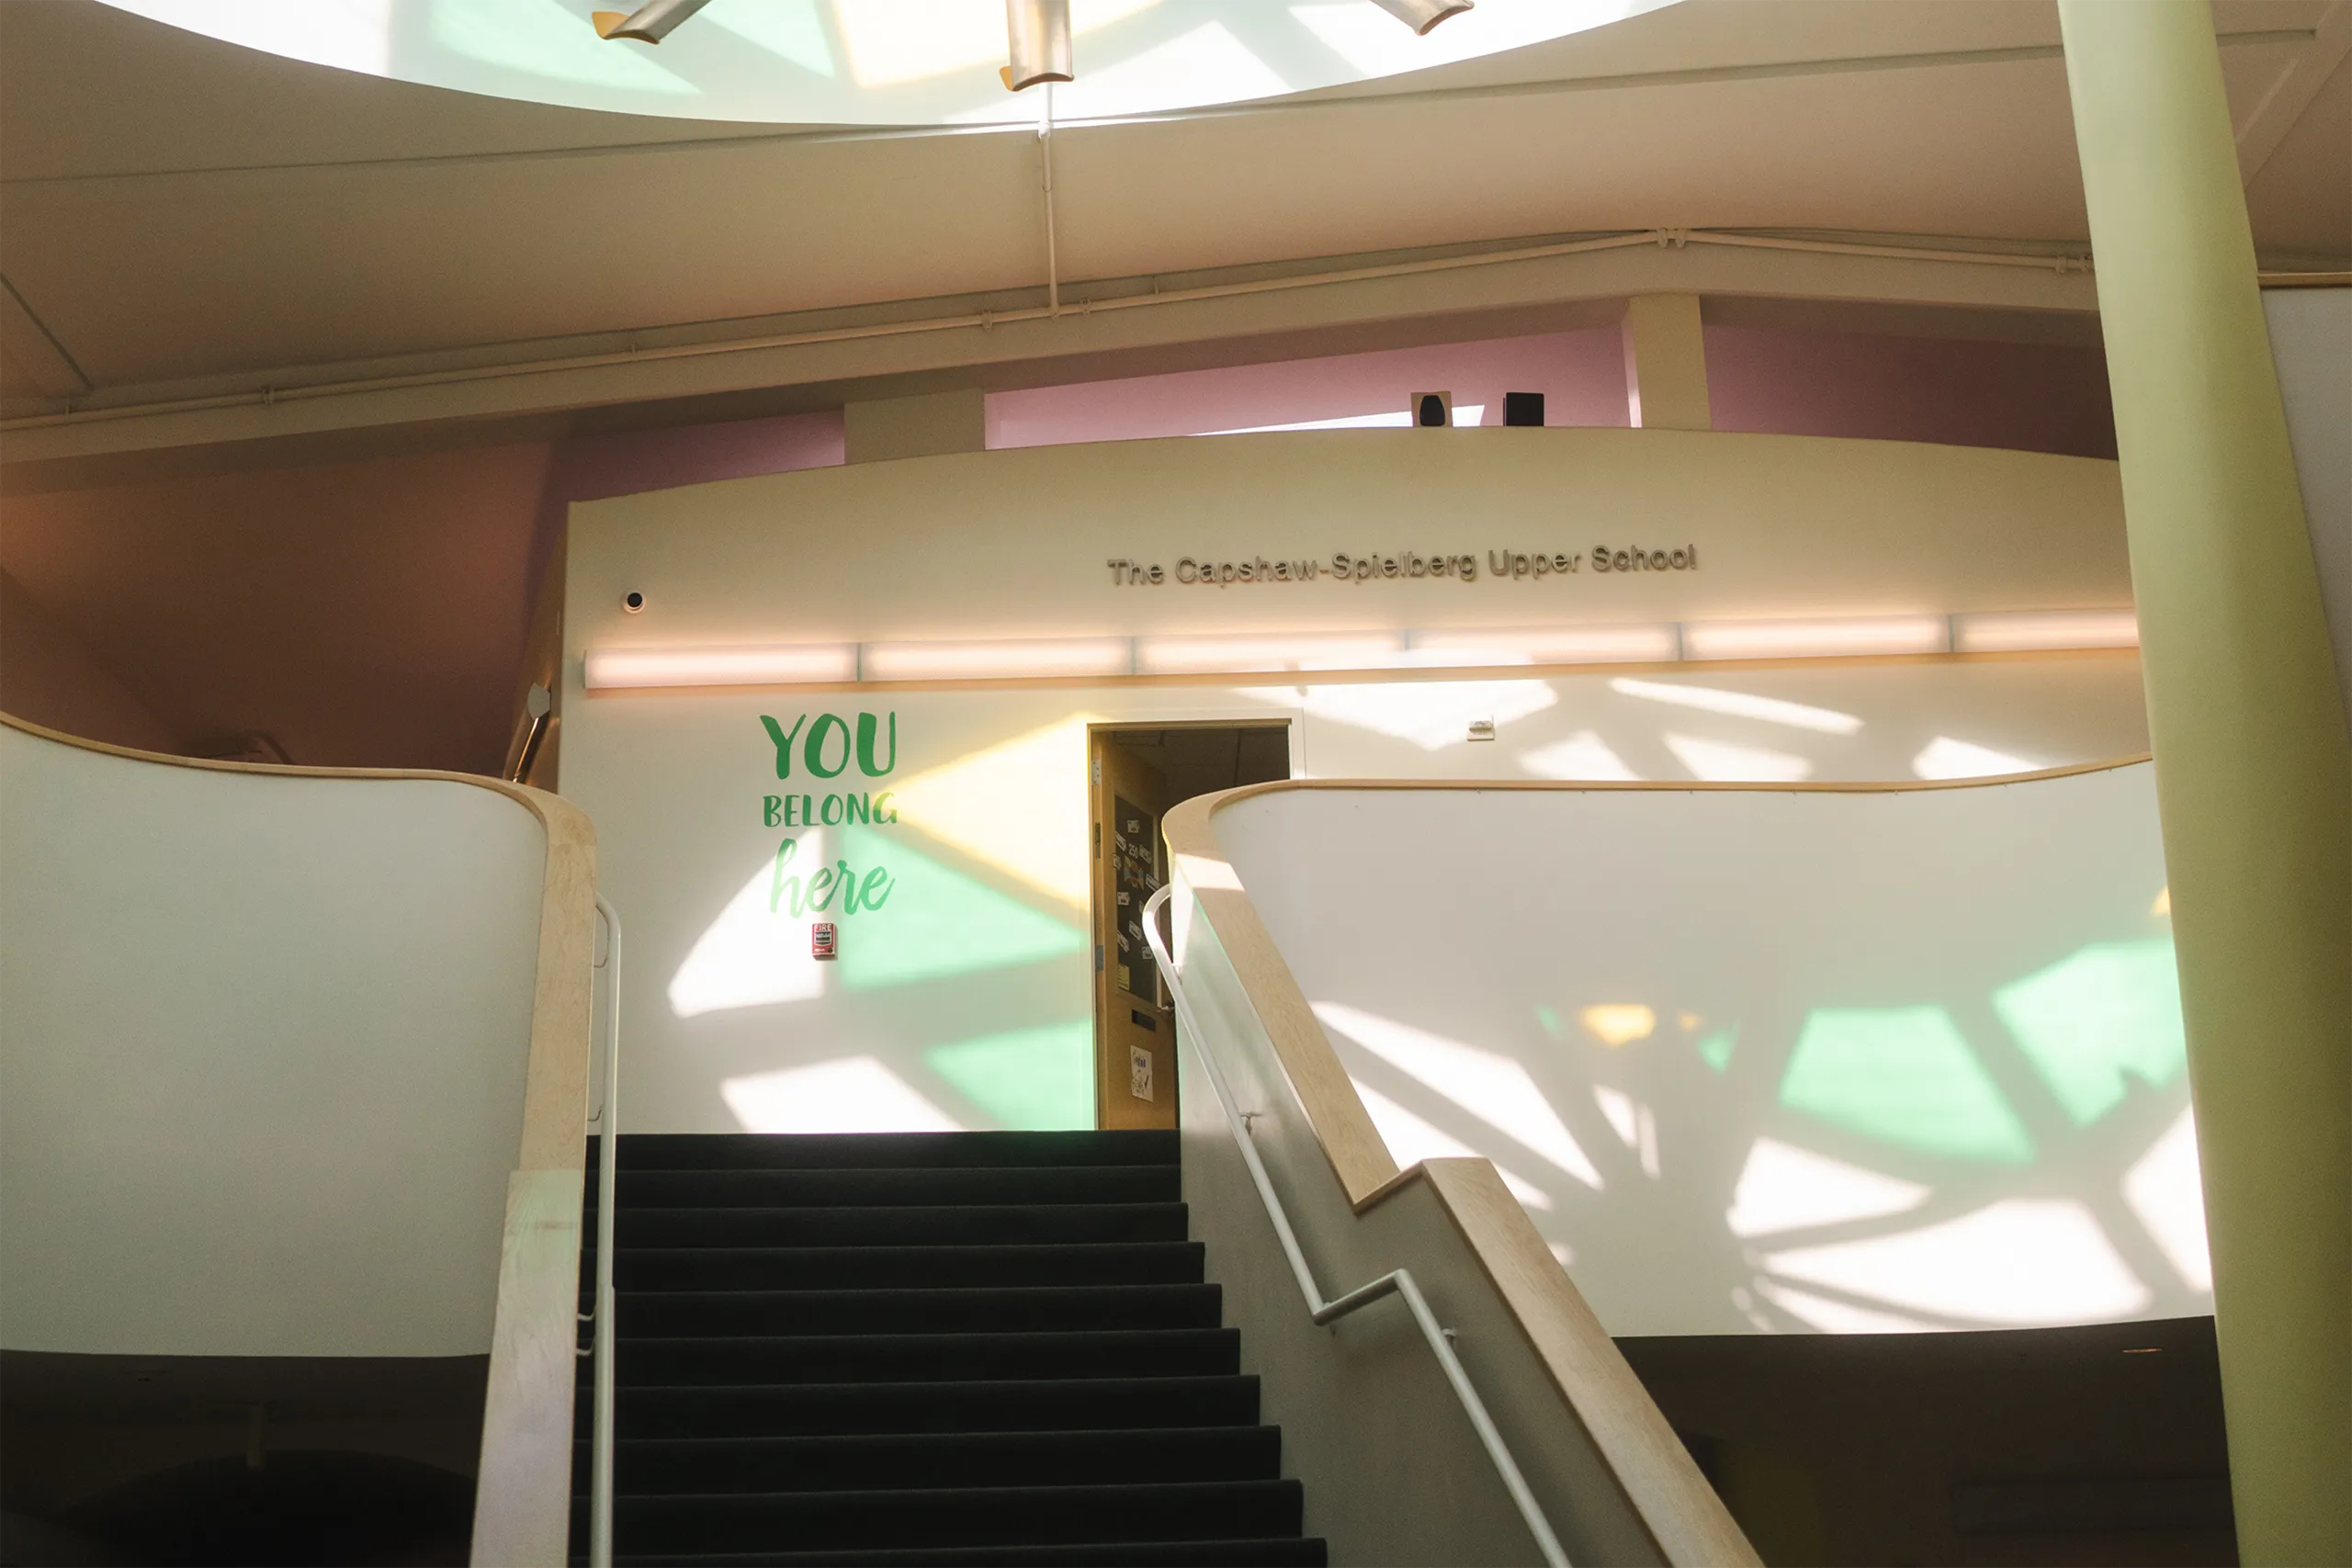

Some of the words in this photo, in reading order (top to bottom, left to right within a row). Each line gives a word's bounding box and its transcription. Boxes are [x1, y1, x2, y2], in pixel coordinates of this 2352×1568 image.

[1108, 558, 1164, 585] The
[1175, 551, 1476, 588] Capshaw-Spielberg
[1488, 548, 1582, 581] Upper
[1590, 544, 1697, 572] School
[760, 711, 896, 780] YOU
[763, 792, 898, 828] BELONG
[769, 838, 896, 919] here
[814, 923, 831, 931] FIRE
